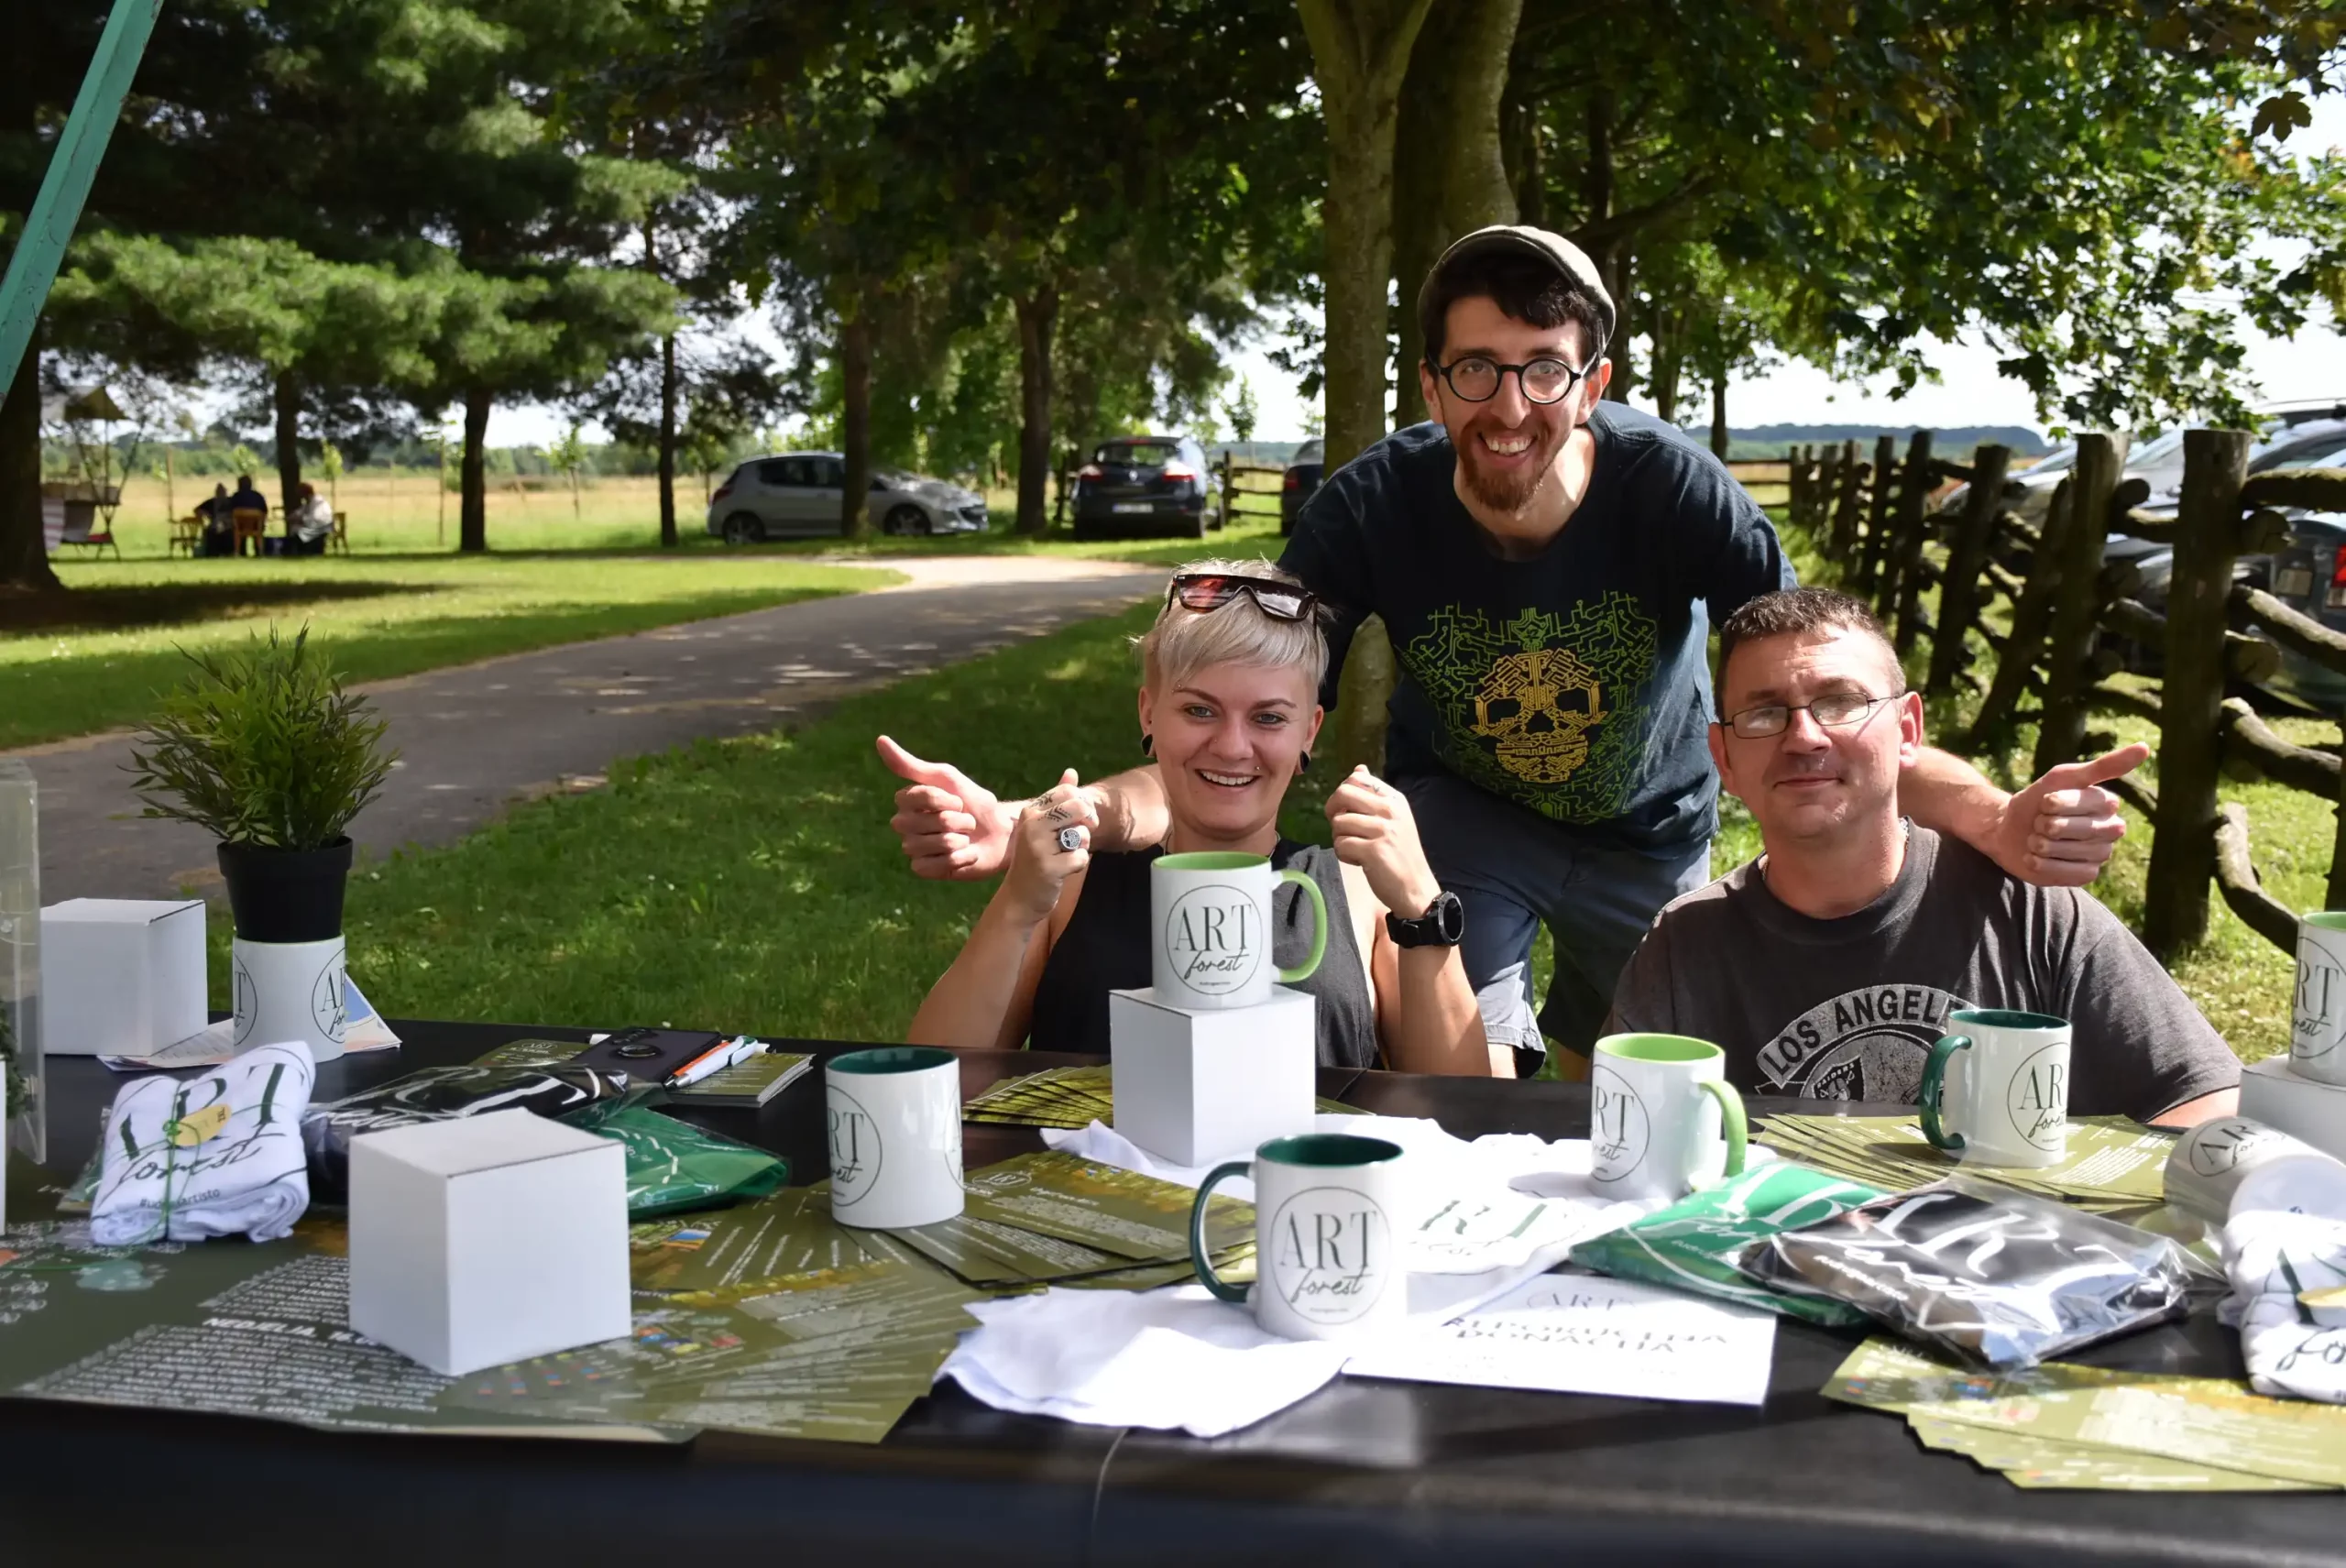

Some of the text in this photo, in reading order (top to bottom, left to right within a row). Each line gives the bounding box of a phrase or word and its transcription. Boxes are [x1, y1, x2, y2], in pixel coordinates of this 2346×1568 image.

[1173, 904, 1252, 952] ART
[1183, 949, 1250, 980] forest
[1762, 988, 1964, 1077] LOS ANGEL
[1279, 1210, 1377, 1270] ART
[1290, 1266, 1374, 1303] forest
